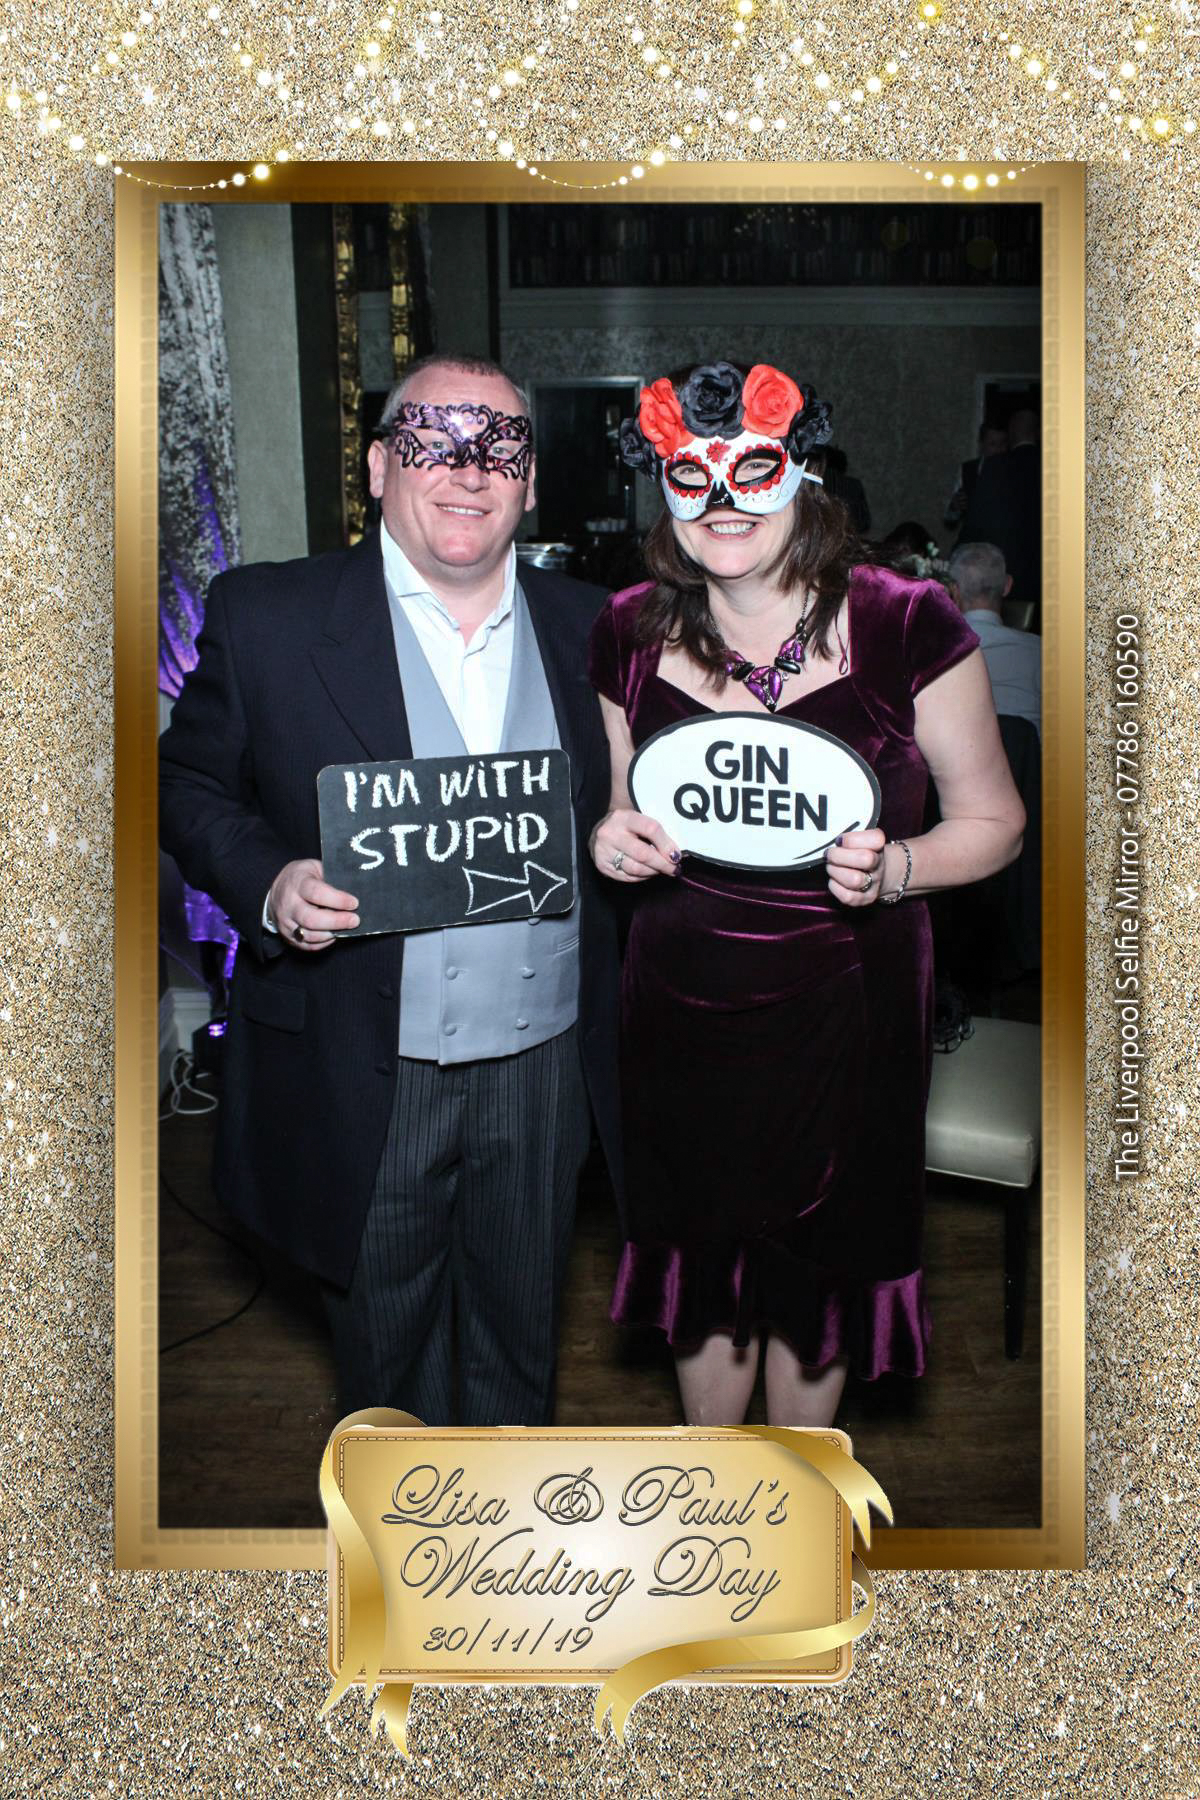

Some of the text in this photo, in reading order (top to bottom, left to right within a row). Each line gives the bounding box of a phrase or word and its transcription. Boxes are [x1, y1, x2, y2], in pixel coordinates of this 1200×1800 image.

[704, 740, 788, 785] GIN
[344, 769, 422, 812] I'M
[673, 782, 828, 832] QUEEN
